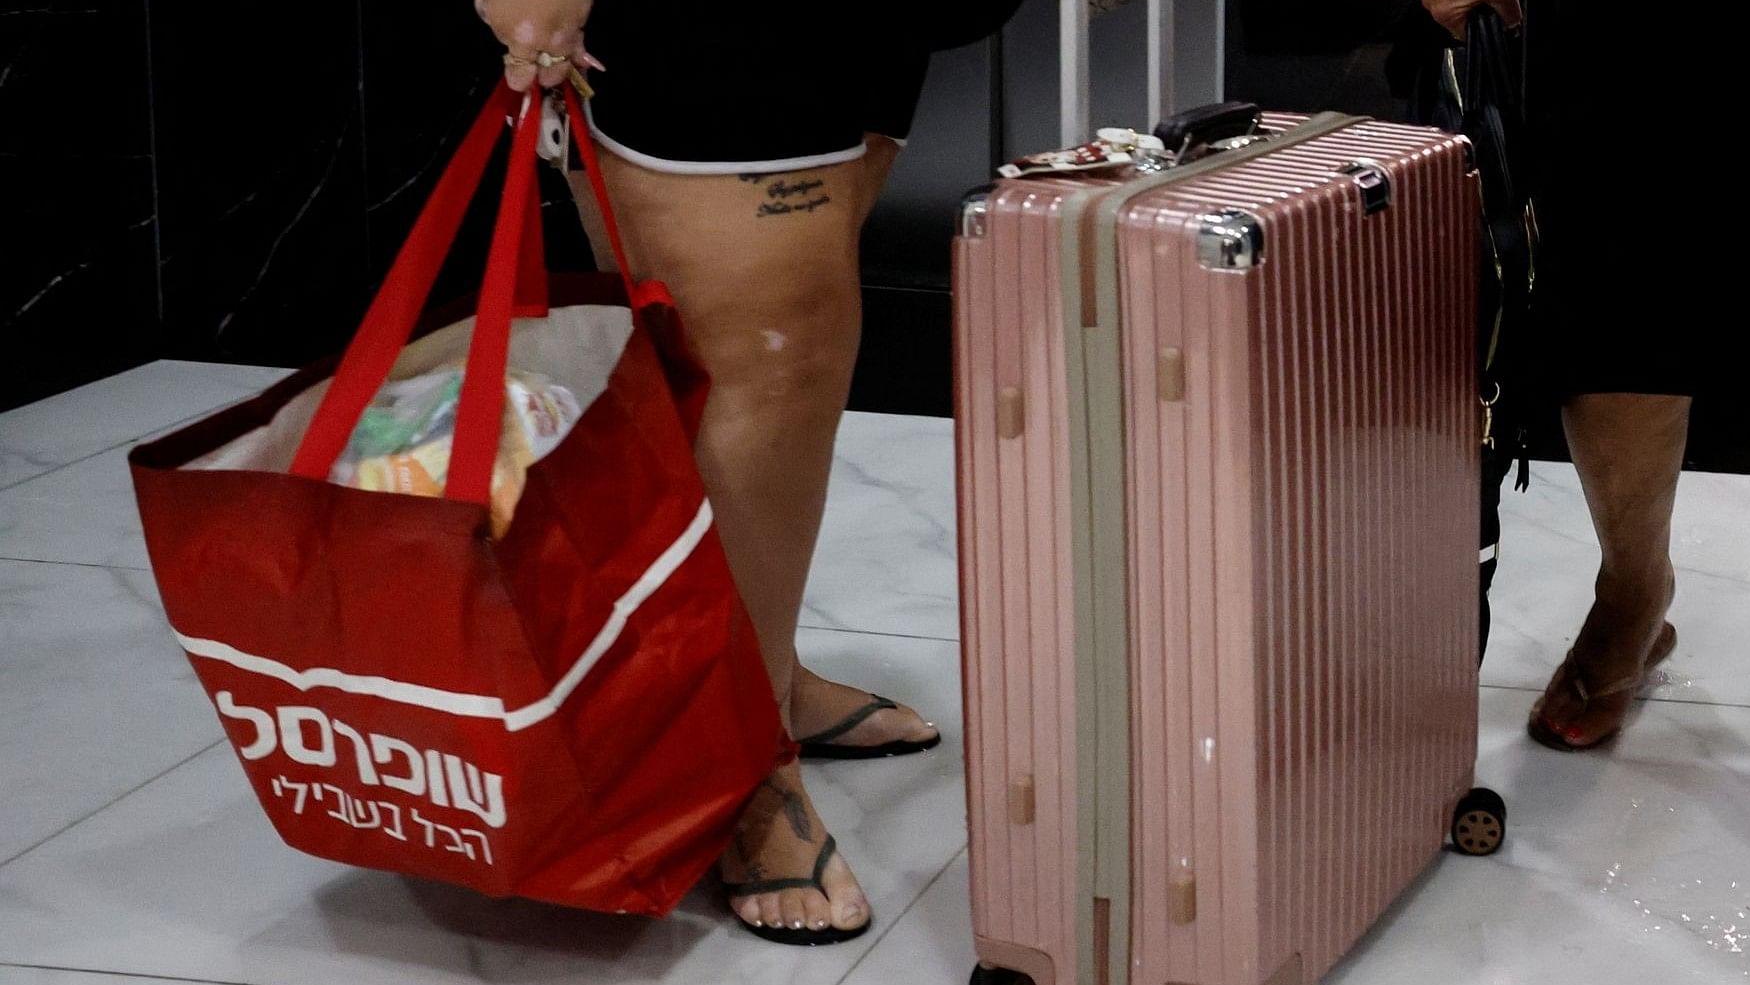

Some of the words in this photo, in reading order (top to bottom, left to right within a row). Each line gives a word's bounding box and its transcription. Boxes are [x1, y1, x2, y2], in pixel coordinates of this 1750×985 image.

[215, 690, 507, 828] שופרסל
[271, 774, 407, 842] בשבילי
[410, 807, 493, 866] הכל
